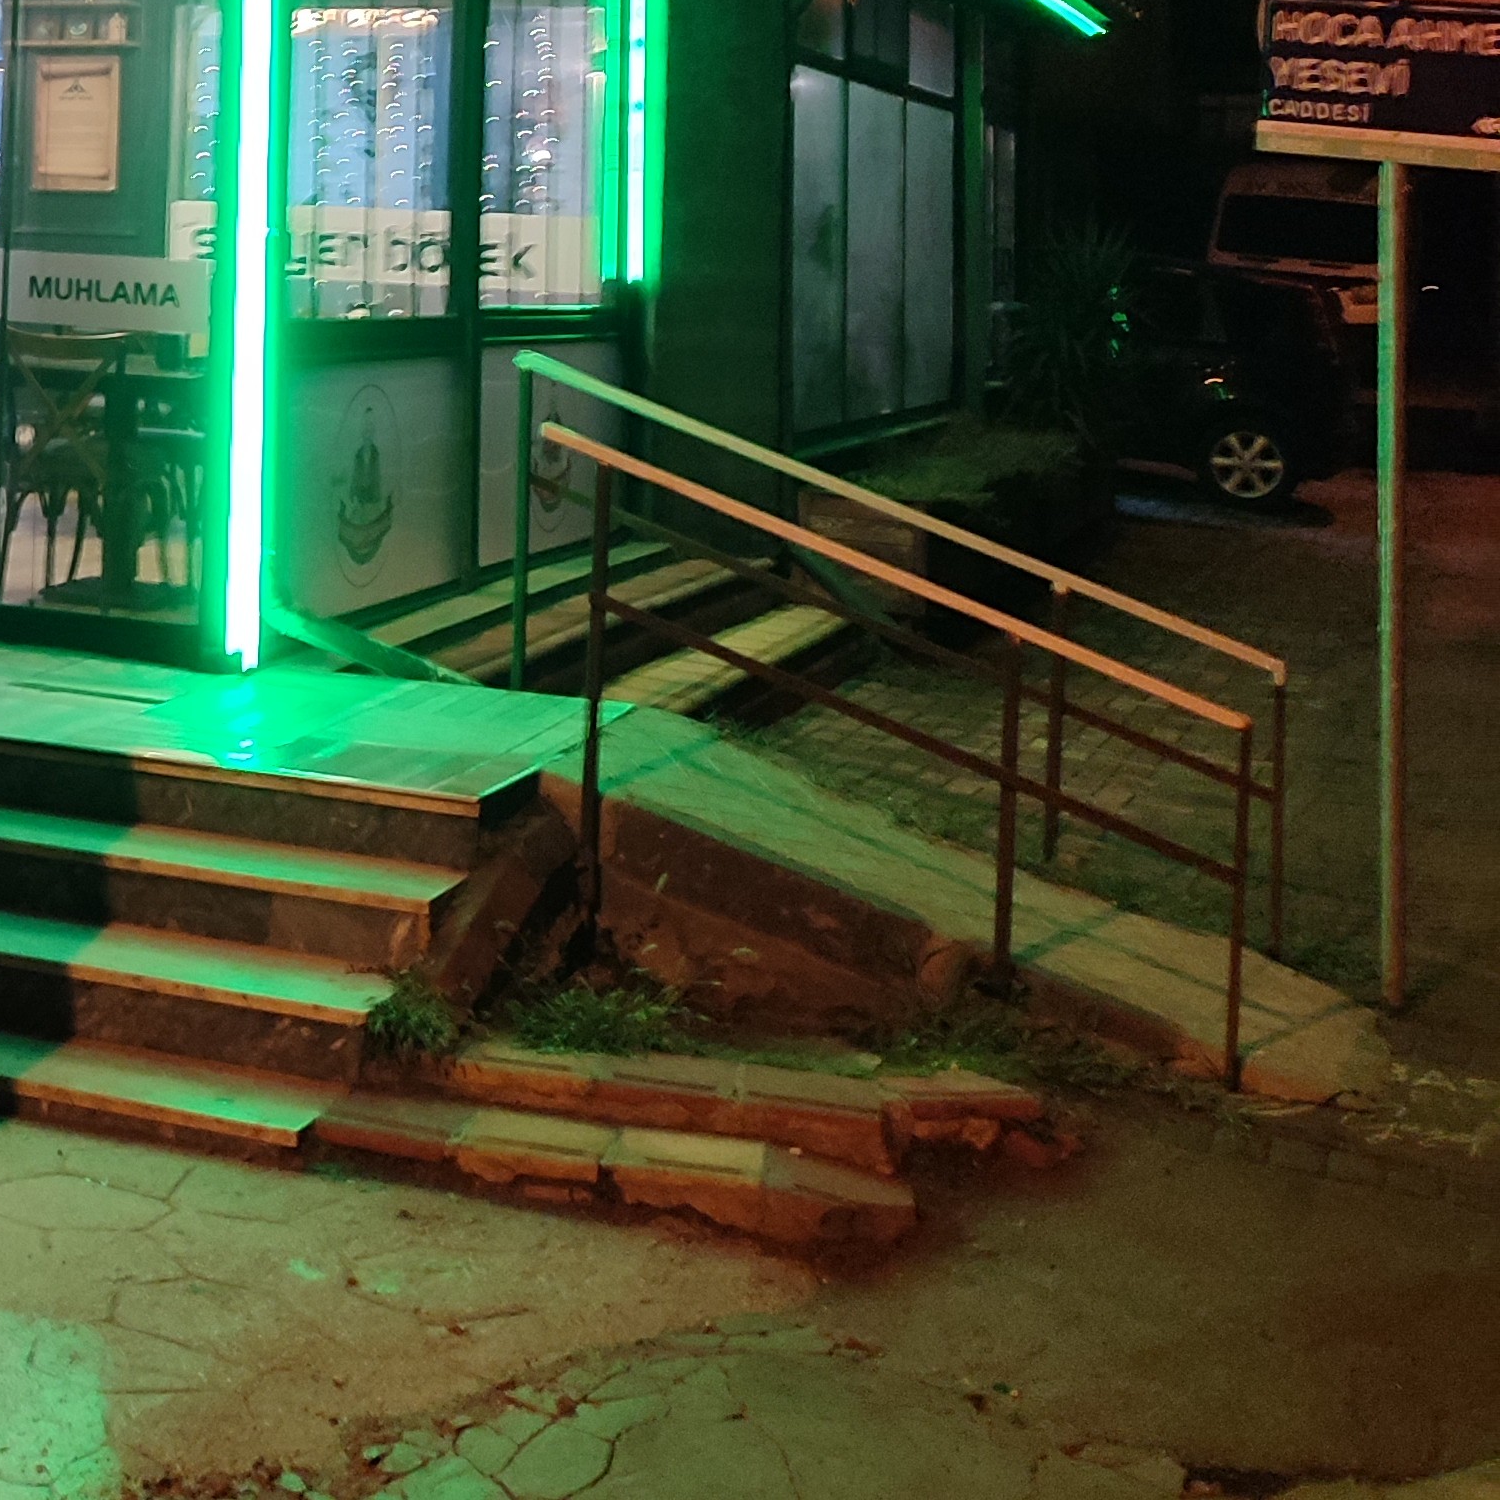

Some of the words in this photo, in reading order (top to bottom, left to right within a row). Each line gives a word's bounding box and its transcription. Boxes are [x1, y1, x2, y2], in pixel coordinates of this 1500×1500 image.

[1273, 10, 1384, 47] HOCA
[1385, 17, 1500, 56] AHME
[28, 274, 181, 309] MUHLAMA
